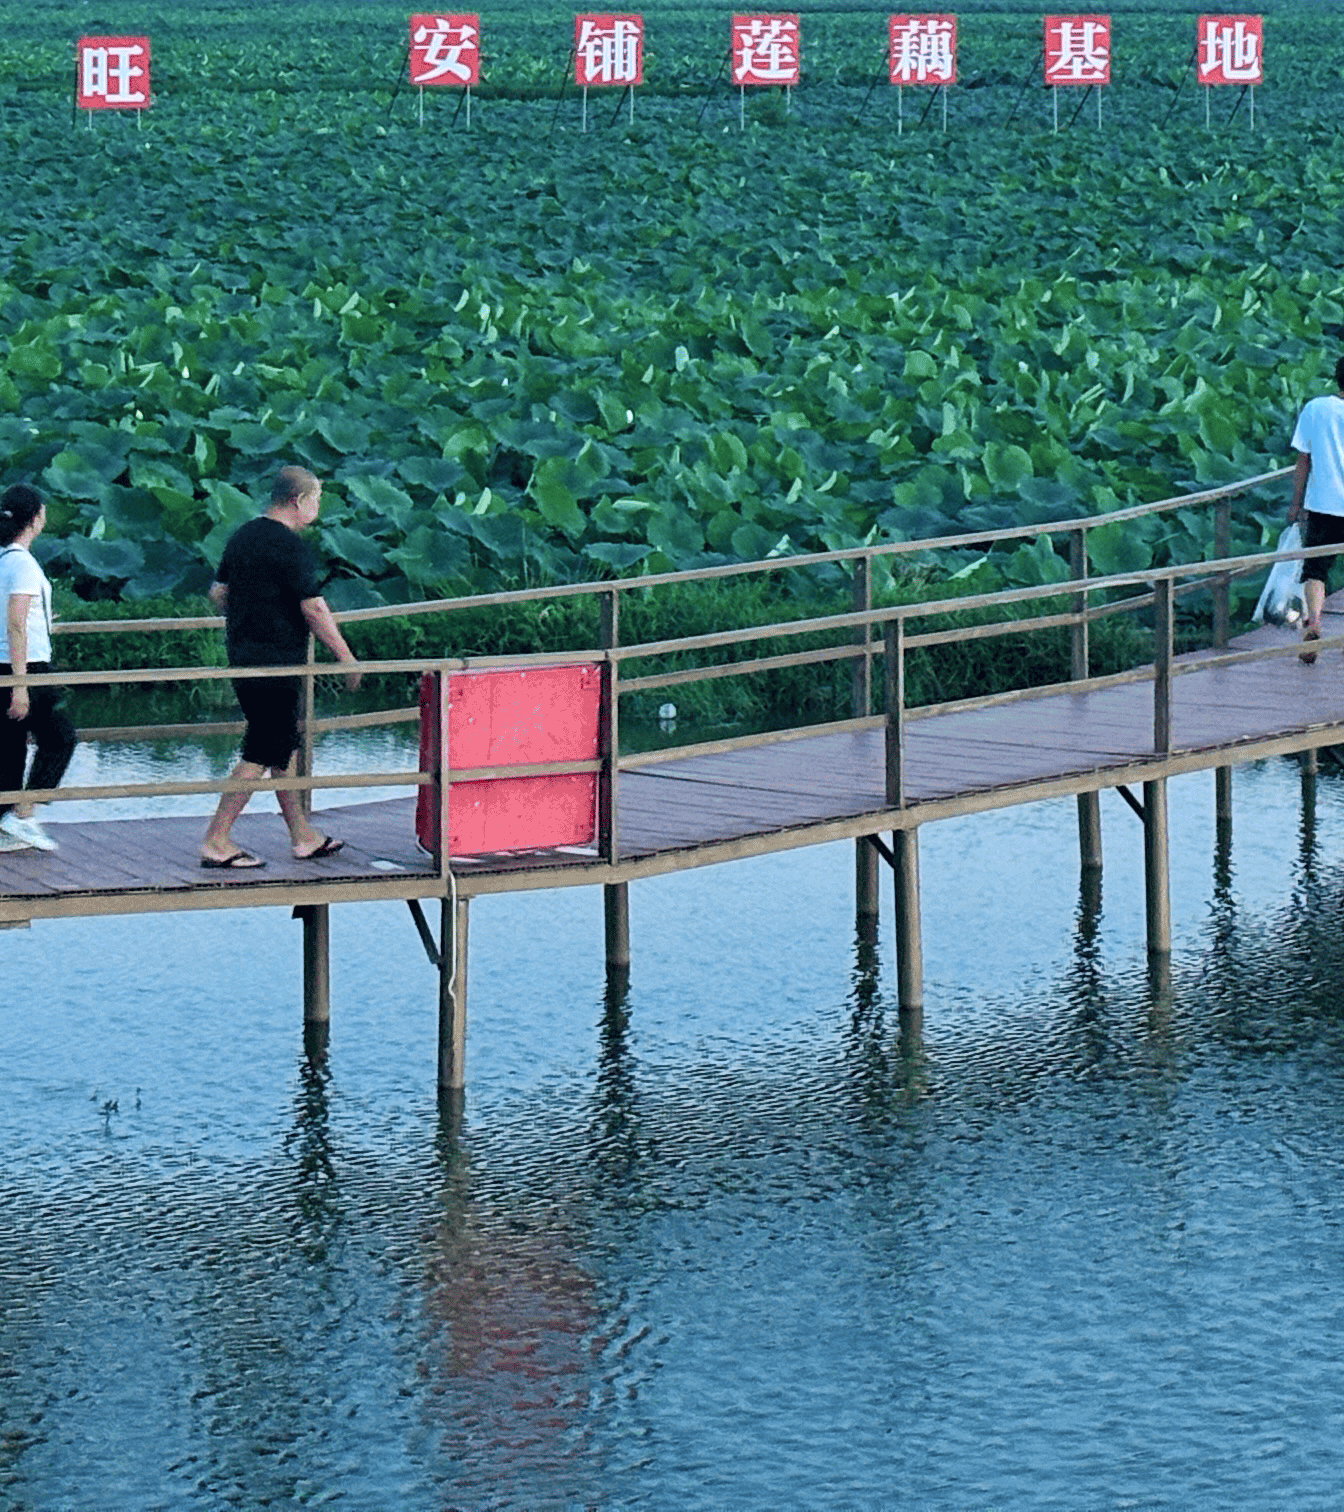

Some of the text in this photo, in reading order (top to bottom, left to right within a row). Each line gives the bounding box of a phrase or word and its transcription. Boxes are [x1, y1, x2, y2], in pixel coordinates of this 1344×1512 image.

[411, 18, 1262, 83] 安铺莲藕基地
